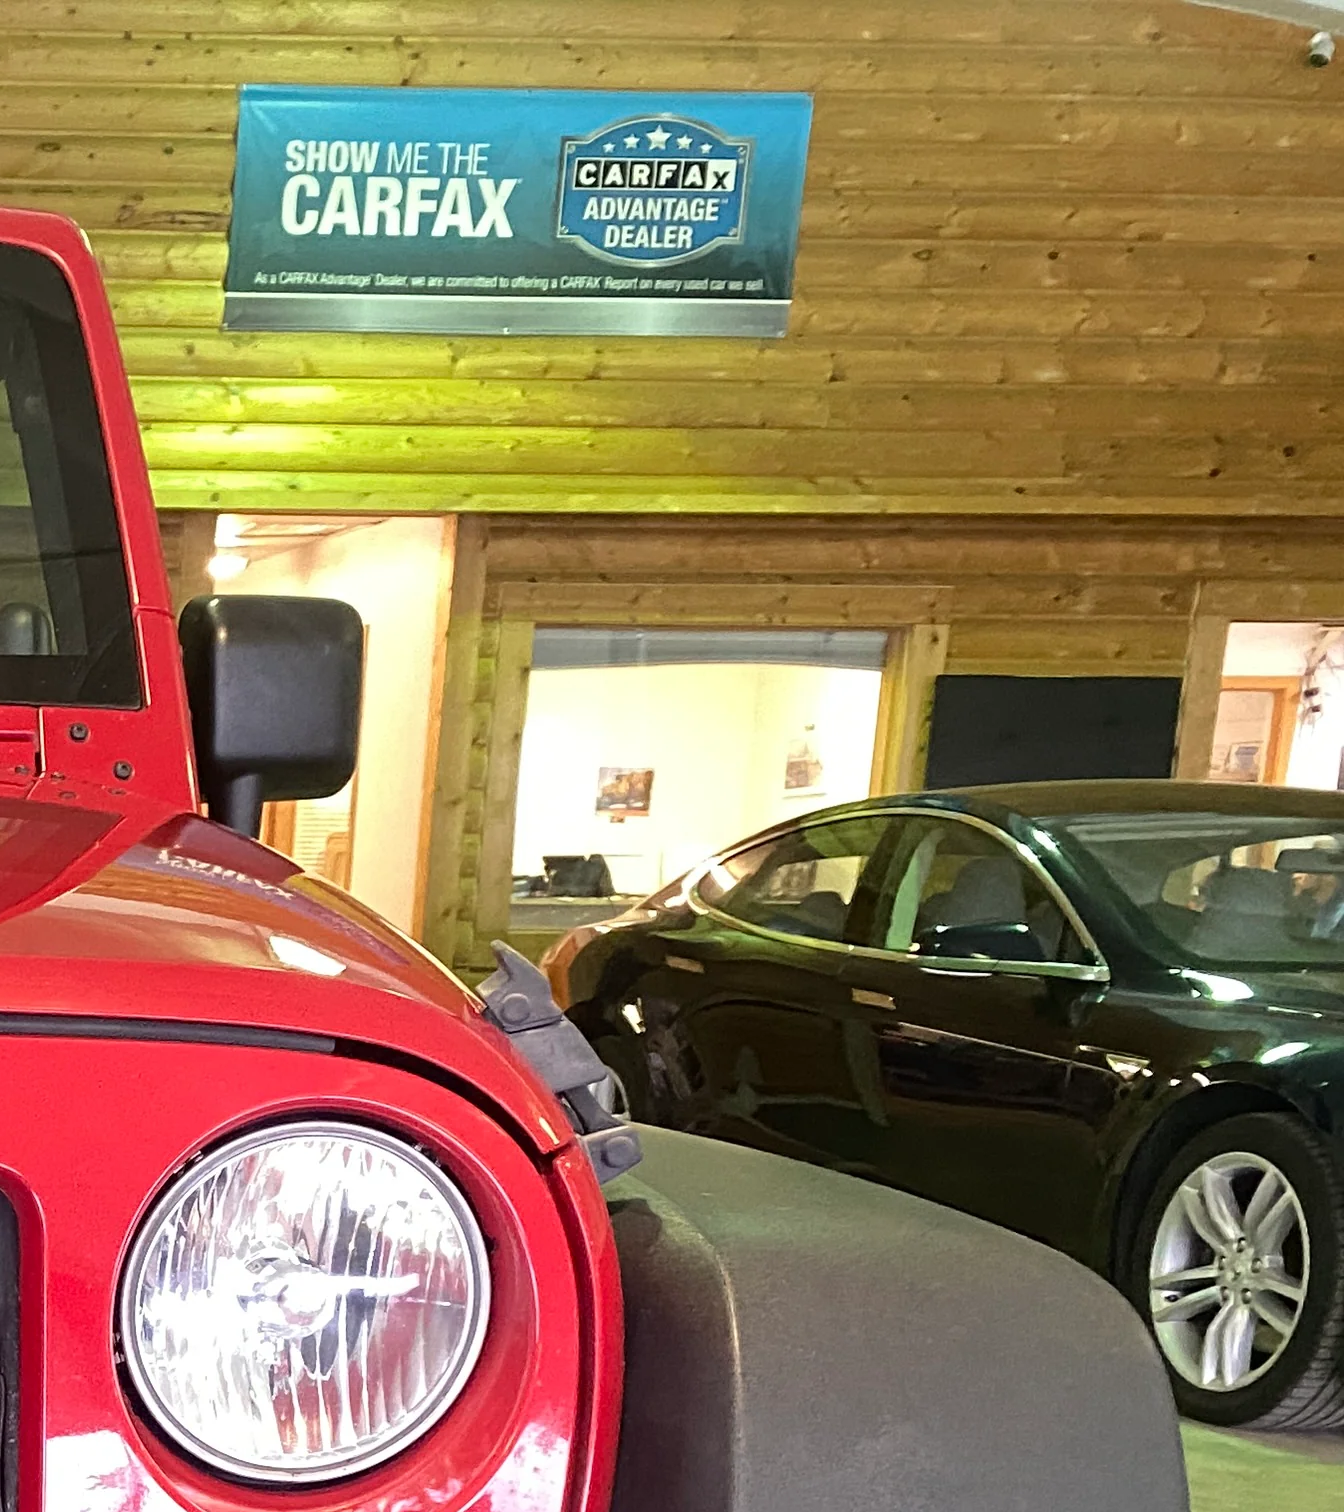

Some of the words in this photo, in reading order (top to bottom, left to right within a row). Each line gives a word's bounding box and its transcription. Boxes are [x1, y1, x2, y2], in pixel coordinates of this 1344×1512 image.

[285, 139, 380, 173] SHOW
[387, 142, 430, 174] ME
[435, 142, 491, 175] THE
[578, 162, 731, 190] CARFAX
[281, 174, 519, 238] CARFAX
[583, 196, 721, 222] ADVANTAGE
[604, 225, 694, 249] DEALER
[279, 271, 319, 285] CARFAX
